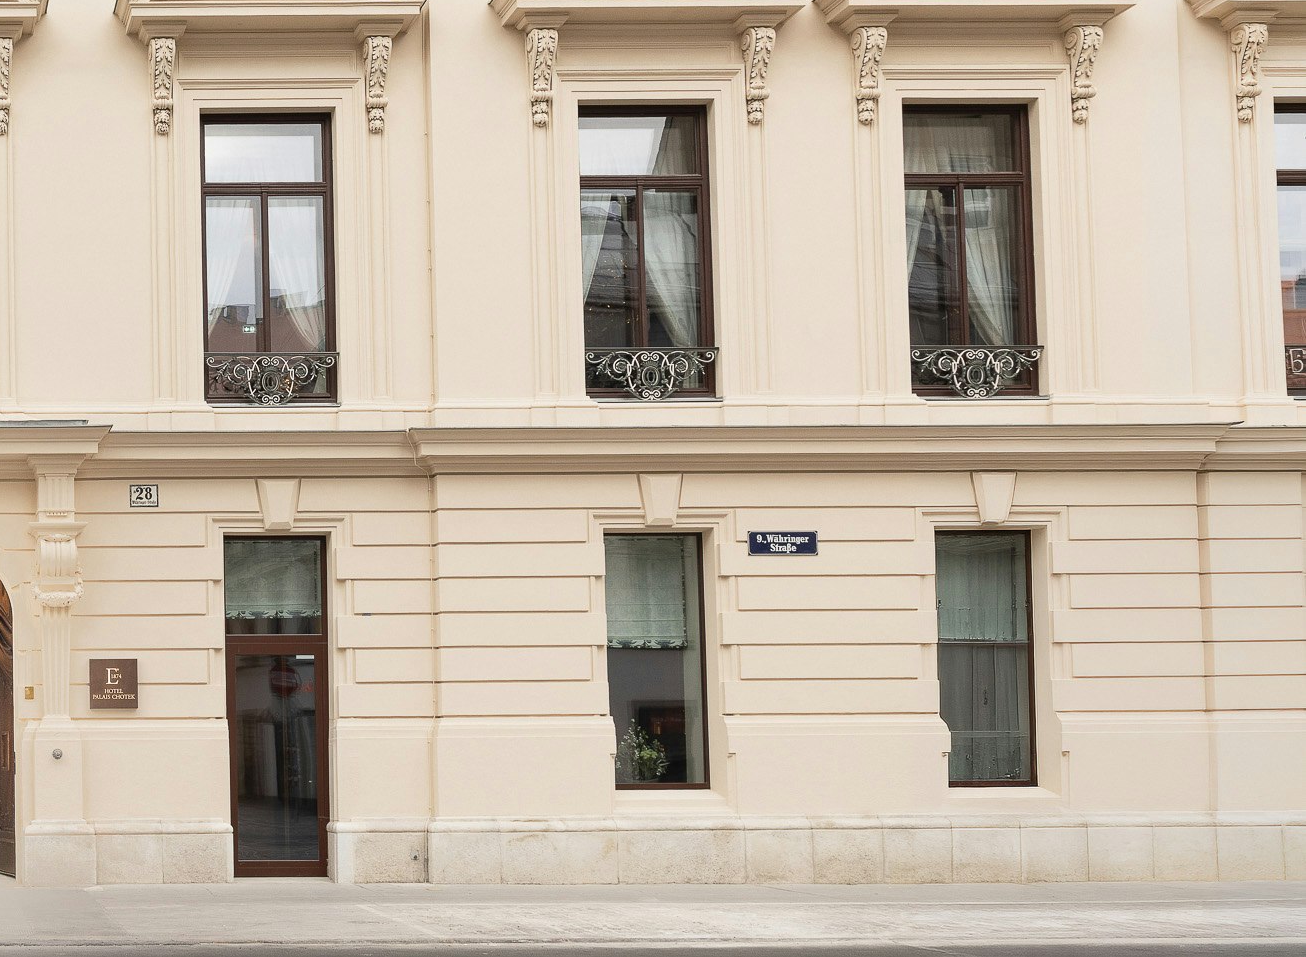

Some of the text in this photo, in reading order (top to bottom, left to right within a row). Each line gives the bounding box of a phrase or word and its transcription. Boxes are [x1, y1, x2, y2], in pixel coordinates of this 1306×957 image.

[135, 486, 153, 501] 28
[770, 543, 797, 554] Straße
[105, 667, 120, 685] E
